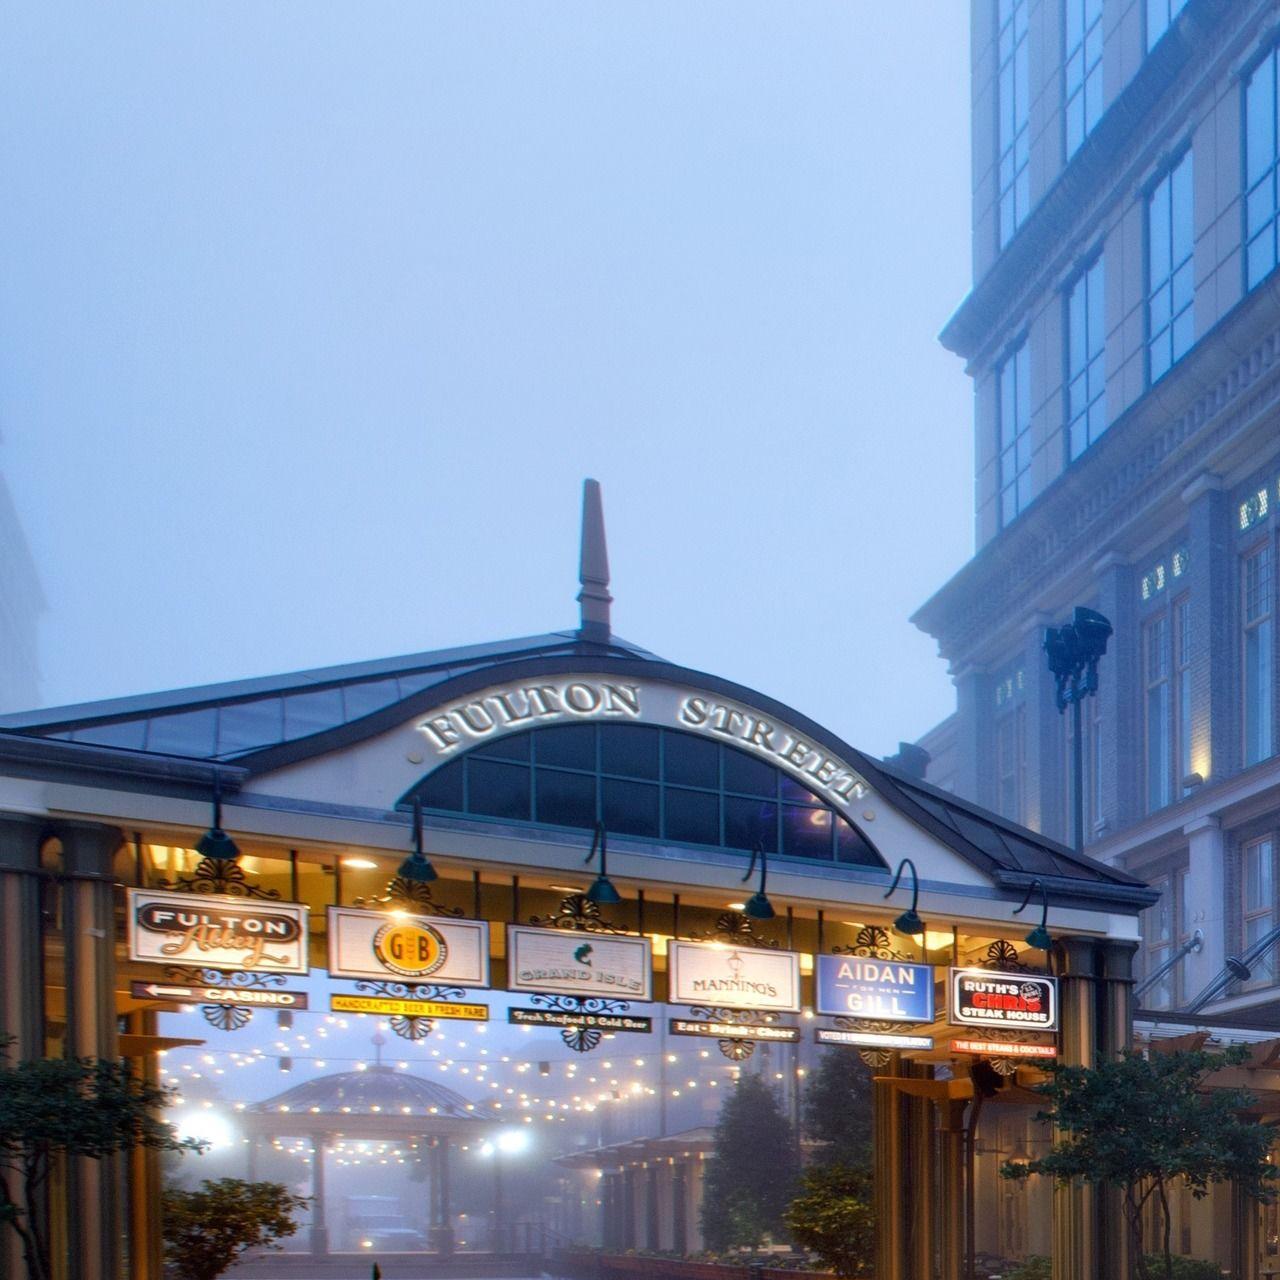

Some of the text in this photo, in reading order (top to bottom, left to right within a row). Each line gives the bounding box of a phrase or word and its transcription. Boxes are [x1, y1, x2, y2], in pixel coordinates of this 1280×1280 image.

[419, 682, 868, 805] FULTON STREET
[152, 910, 287, 935] FULTON
[519, 967, 643, 991] GRAND ISLE
[838, 962, 915, 986] AIDAN
[203, 988, 296, 1005] CASINO
[692, 978, 778, 998] MANNING'S
[964, 980, 1019, 995] RUTH'S
[335, 1000, 401, 1012] HANDCRAFTED
[403, 1002, 425, 1013] BEER
[435, 1005, 461, 1015] FRESH
[464, 1006, 485, 1017] FARE
[847, 993, 907, 1016] GILL
[971, 992, 1041, 1012] CHRIS
[513, 1010, 544, 1022] Fresh
[544, 1013, 585, 1025] Seafood
[599, 1016, 622, 1027] Cold
[623, 1018, 647, 1029] Beer
[961, 1007, 1047, 1022] STEAK HOUSE
[676, 1021, 700, 1033] Eat
